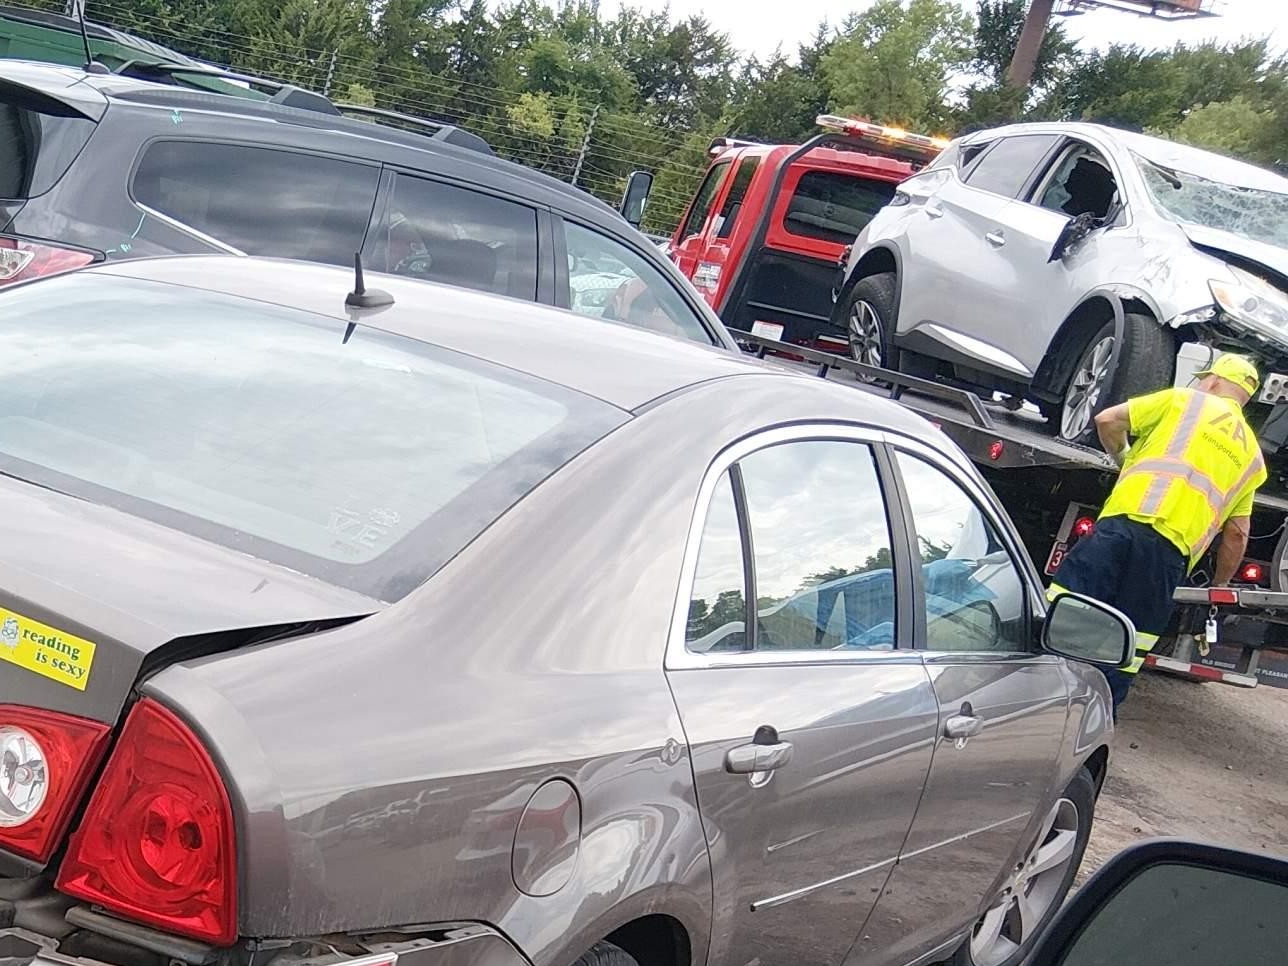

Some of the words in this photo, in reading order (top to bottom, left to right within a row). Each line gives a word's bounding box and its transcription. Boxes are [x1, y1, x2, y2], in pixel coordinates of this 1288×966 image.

[1201, 431, 1242, 470] Transportation
[22, 628, 81, 661] reading
[35, 648, 48, 664] is
[51, 658, 87, 680] sexy
